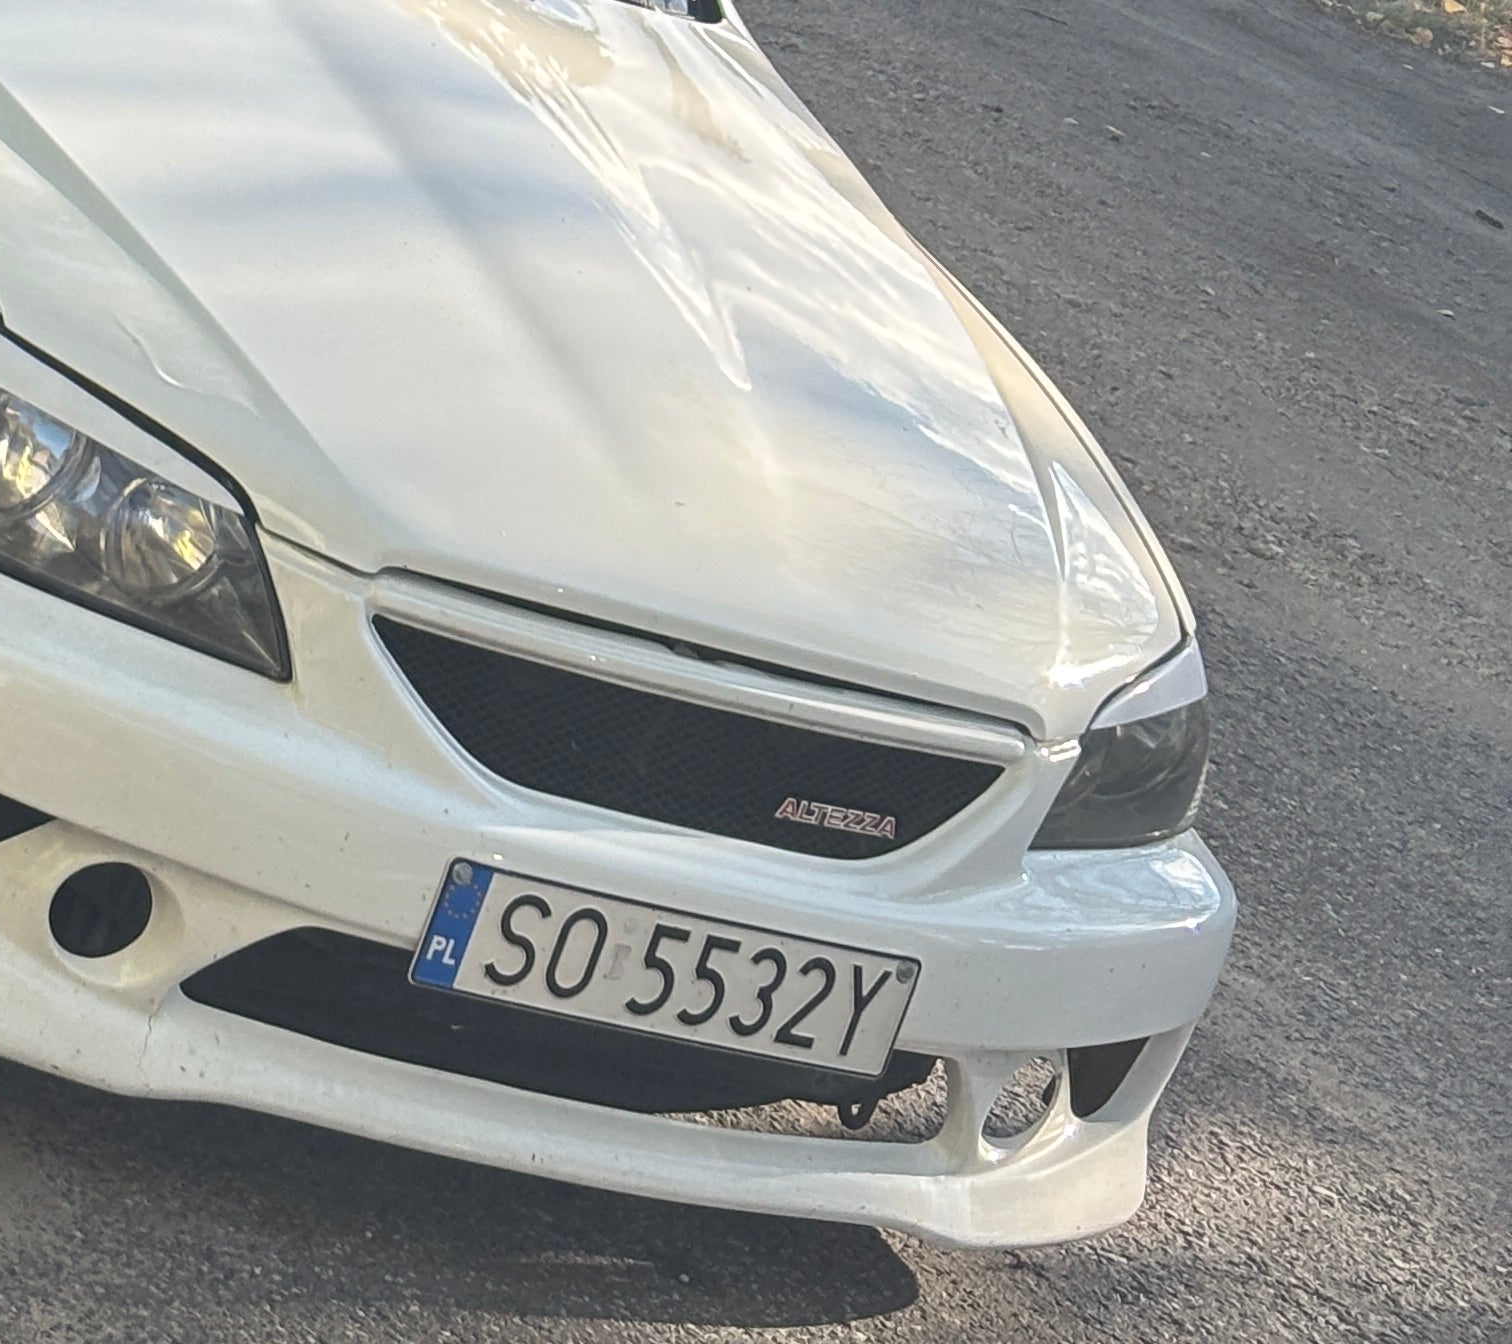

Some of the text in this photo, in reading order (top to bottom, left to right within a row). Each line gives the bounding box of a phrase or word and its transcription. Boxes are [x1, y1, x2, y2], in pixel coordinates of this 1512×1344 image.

[775, 797, 896, 839] ALTEZZA
[426, 936, 456, 966] PL
[484, 894, 892, 1057] SO 5532Y
